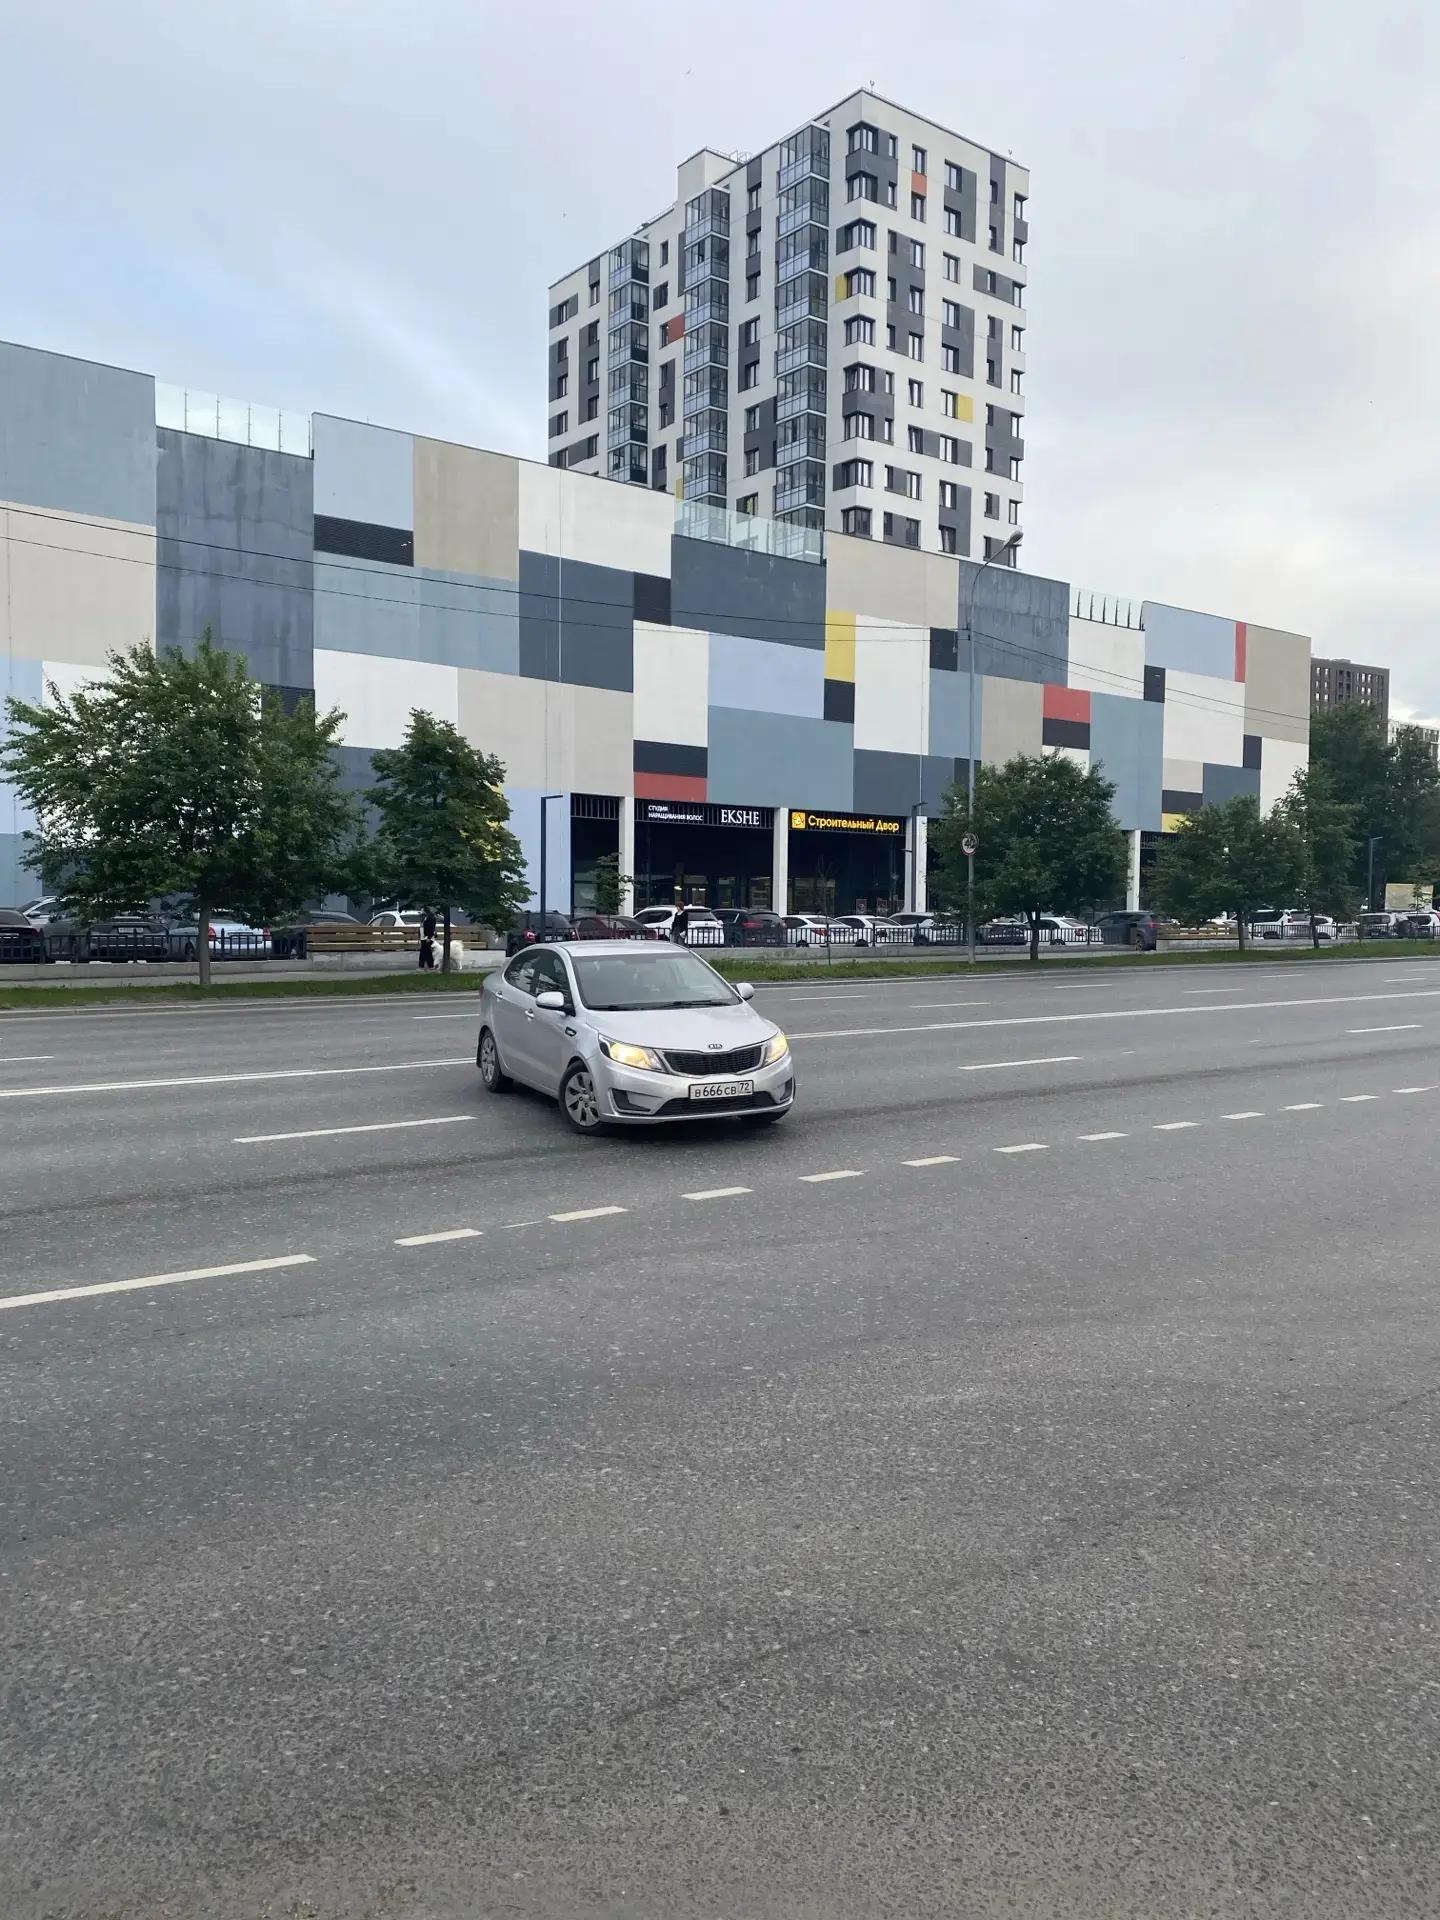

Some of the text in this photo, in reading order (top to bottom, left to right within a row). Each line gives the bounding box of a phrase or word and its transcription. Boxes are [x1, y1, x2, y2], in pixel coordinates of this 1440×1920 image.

[648, 812, 685, 820] НАРАЩИВАНИЯ
[721, 809, 760, 825] EKSHE
[808, 815, 899, 833] Строительный Двор
